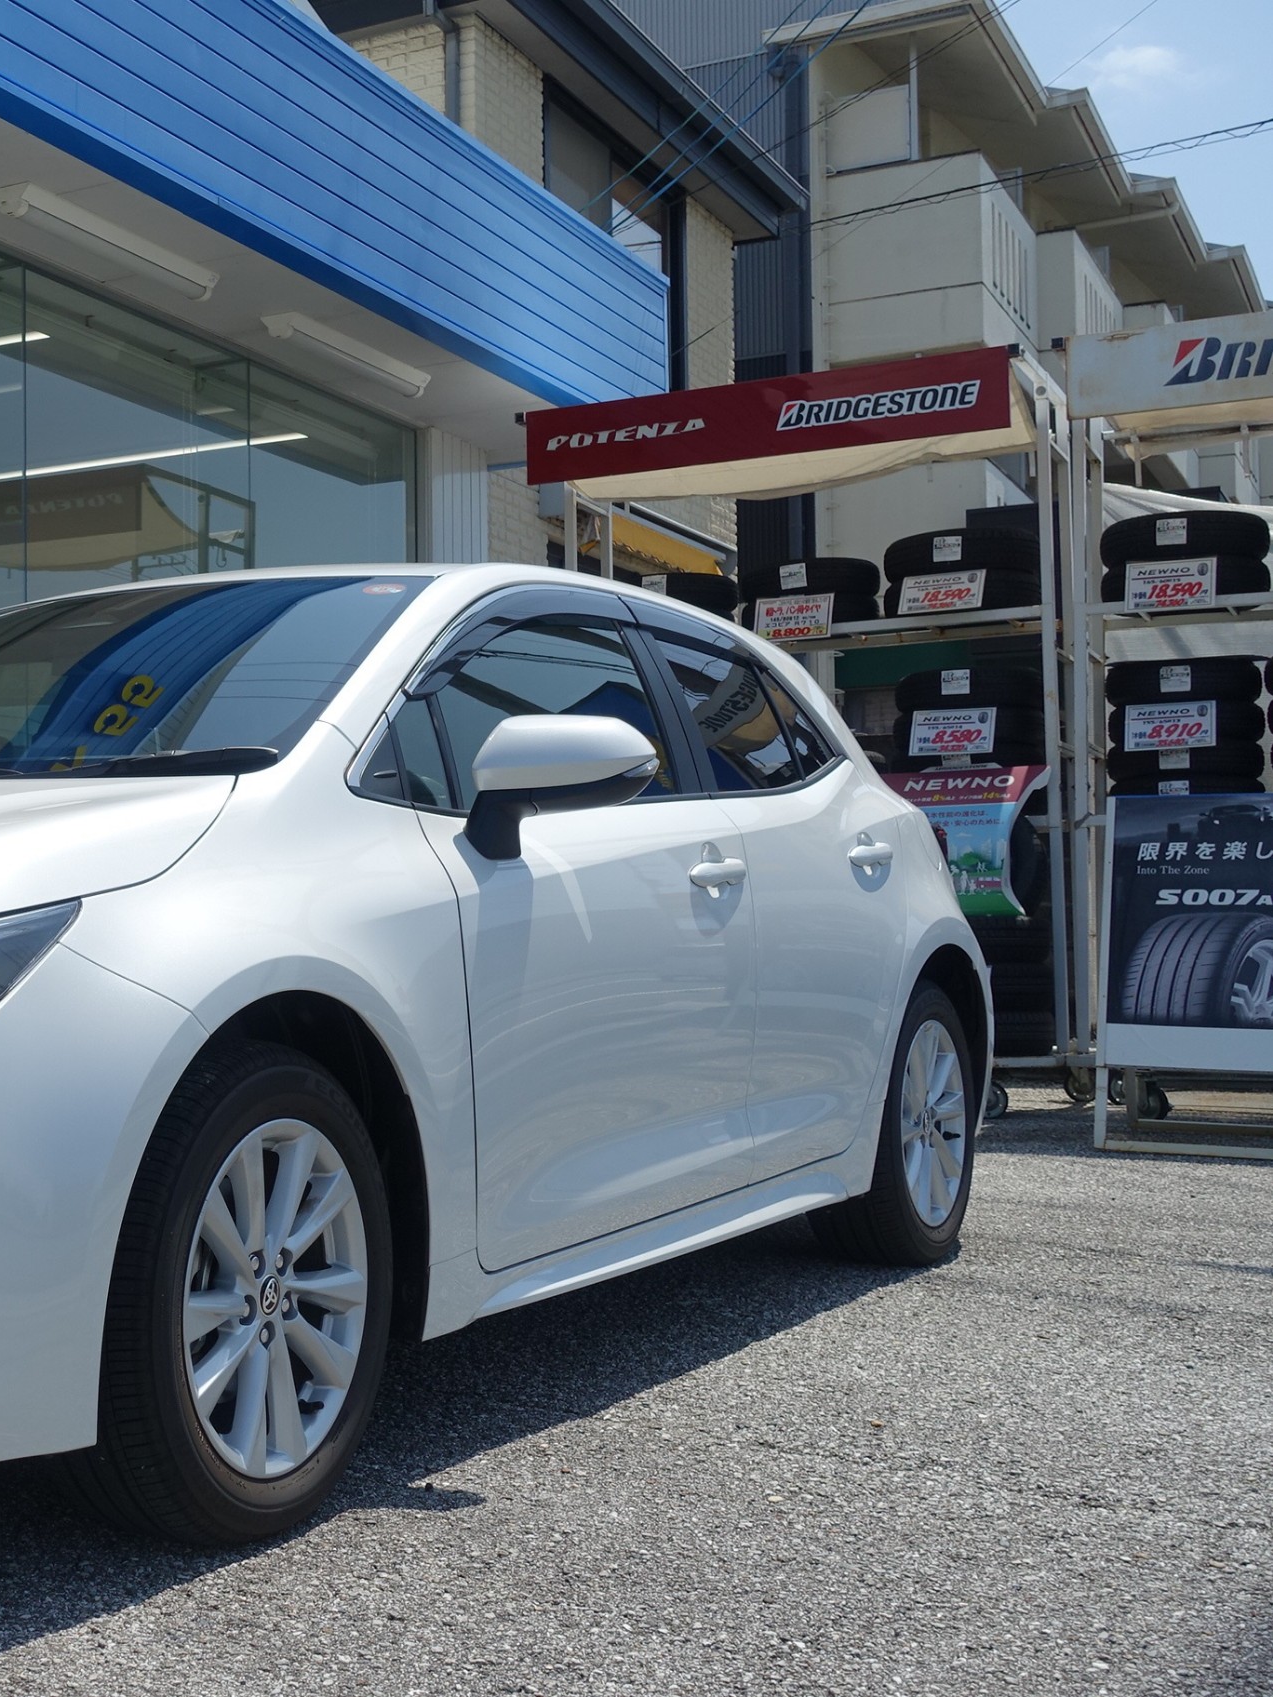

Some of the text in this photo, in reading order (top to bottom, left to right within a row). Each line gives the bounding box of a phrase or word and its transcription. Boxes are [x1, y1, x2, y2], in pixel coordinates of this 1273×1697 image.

[545, 381, 979, 451] POTENZA BRIDGESTONE
[1137, 567, 1190, 576] NEWNO
[913, 577, 962, 585] NEWNO
[1137, 708, 1190, 717] NEWNO
[903, 775, 1015, 792] NEWNO
[1137, 865, 1210, 875] Into The Zone
